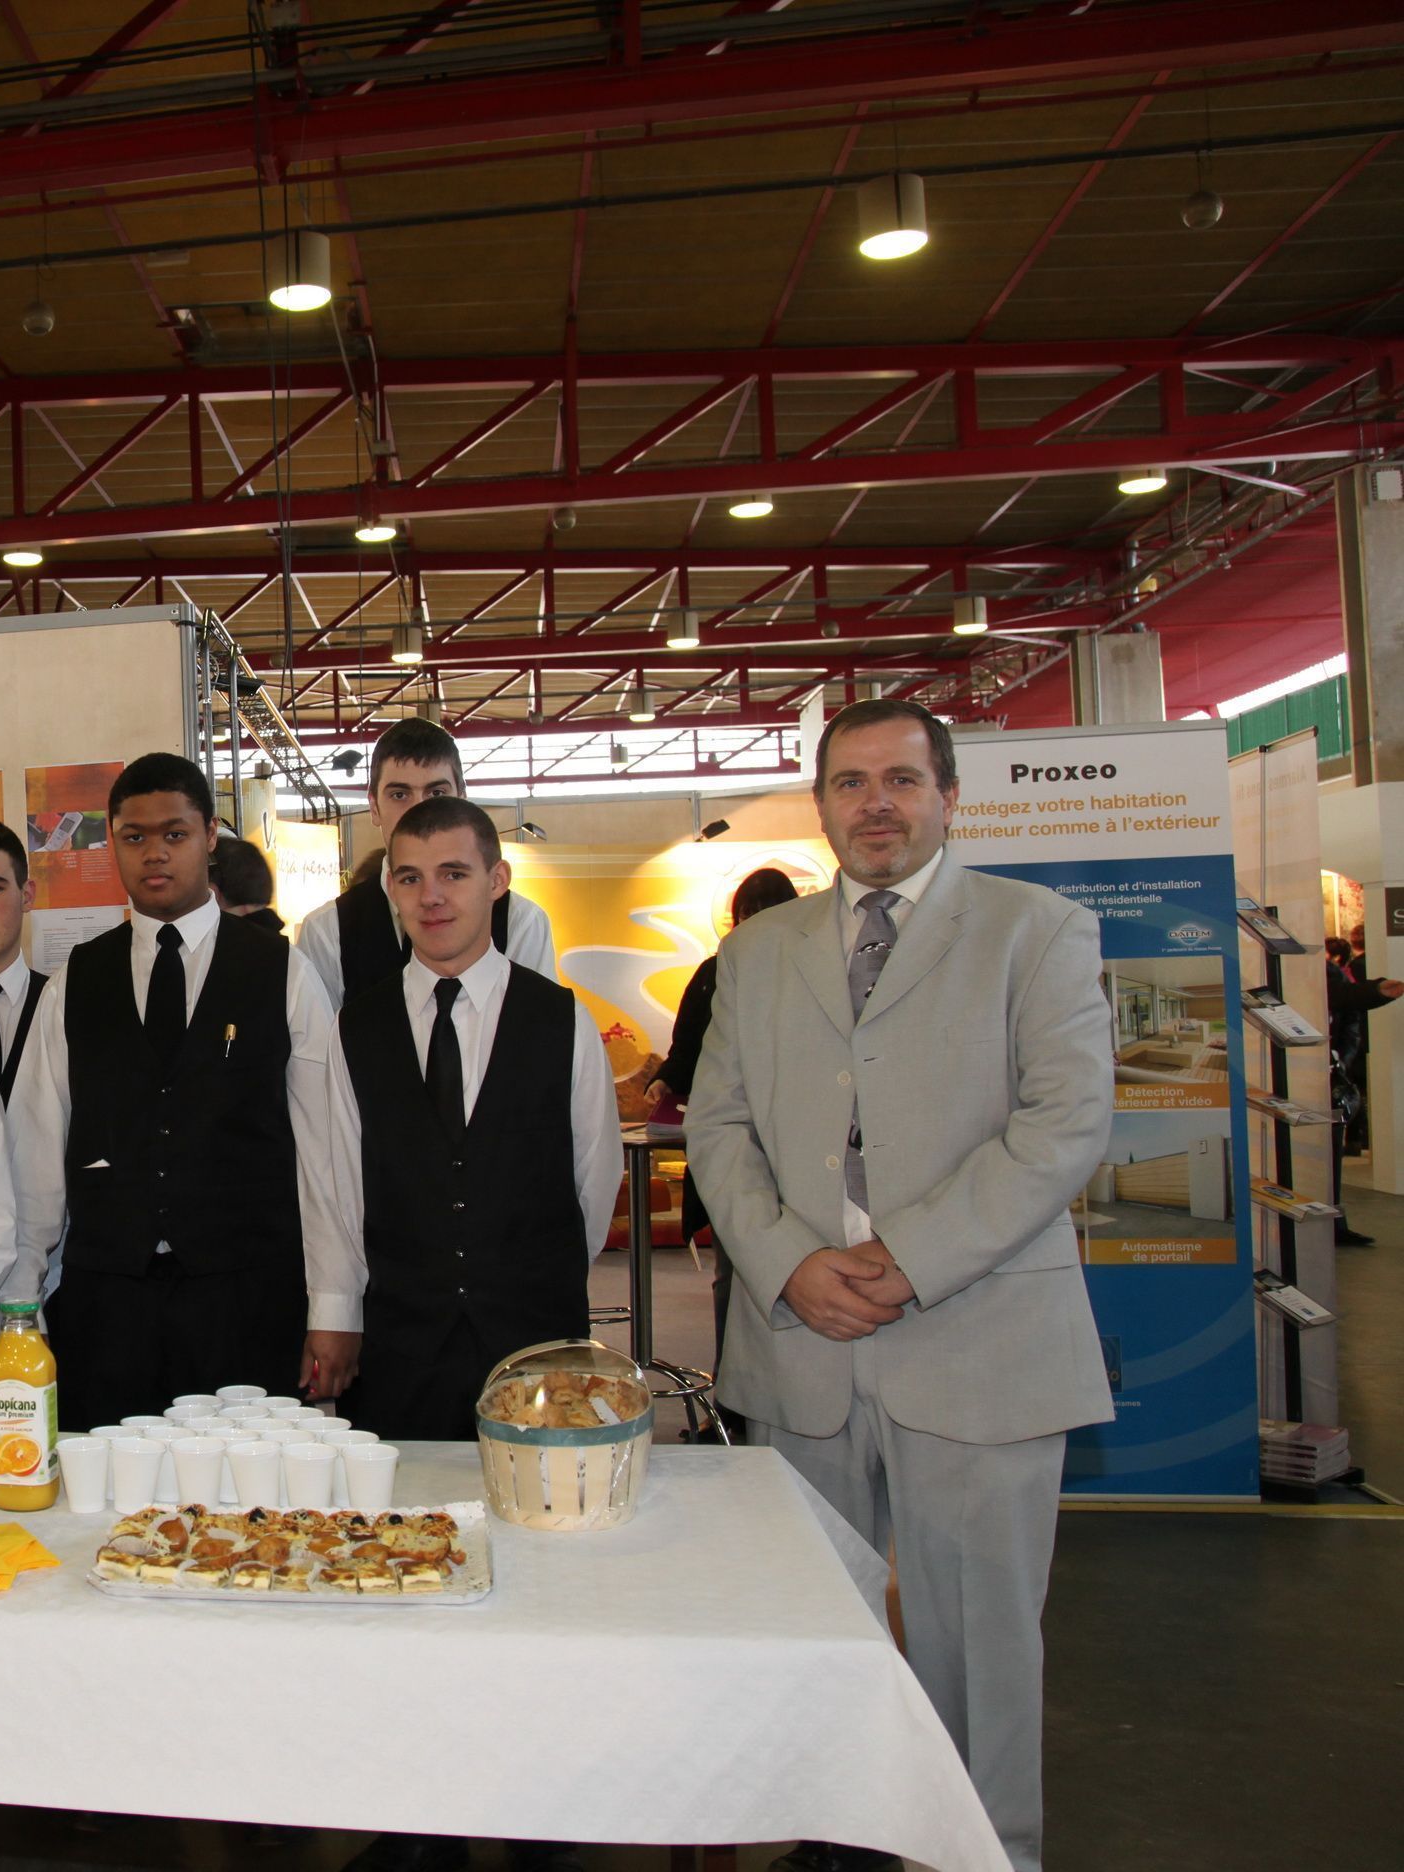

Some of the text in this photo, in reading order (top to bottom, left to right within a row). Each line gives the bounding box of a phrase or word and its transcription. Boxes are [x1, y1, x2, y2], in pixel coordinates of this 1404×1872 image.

[1010, 763, 1117, 784] Proxeo
[1037, 798, 1085, 812] votre
[1090, 792, 1187, 811] habitation
[1028, 821, 1101, 837] comme
[1106, 818, 1118, 833] à
[1123, 814, 1221, 833] l'extérieur
[1055, 879, 1202, 894] distribution et d'installation
[1076, 893, 1163, 906] rité résidentielle
[1106, 907, 1144, 918] France
[1125, 1086, 1185, 1097] Détection
[1163, 1097, 1176, 1107] et
[1179, 1095, 1212, 1107] vidéo
[1121, 1242, 1202, 1252] Automatisme
[1132, 1251, 1191, 1264] de portail
[8, 1411, 34, 1419] premium
